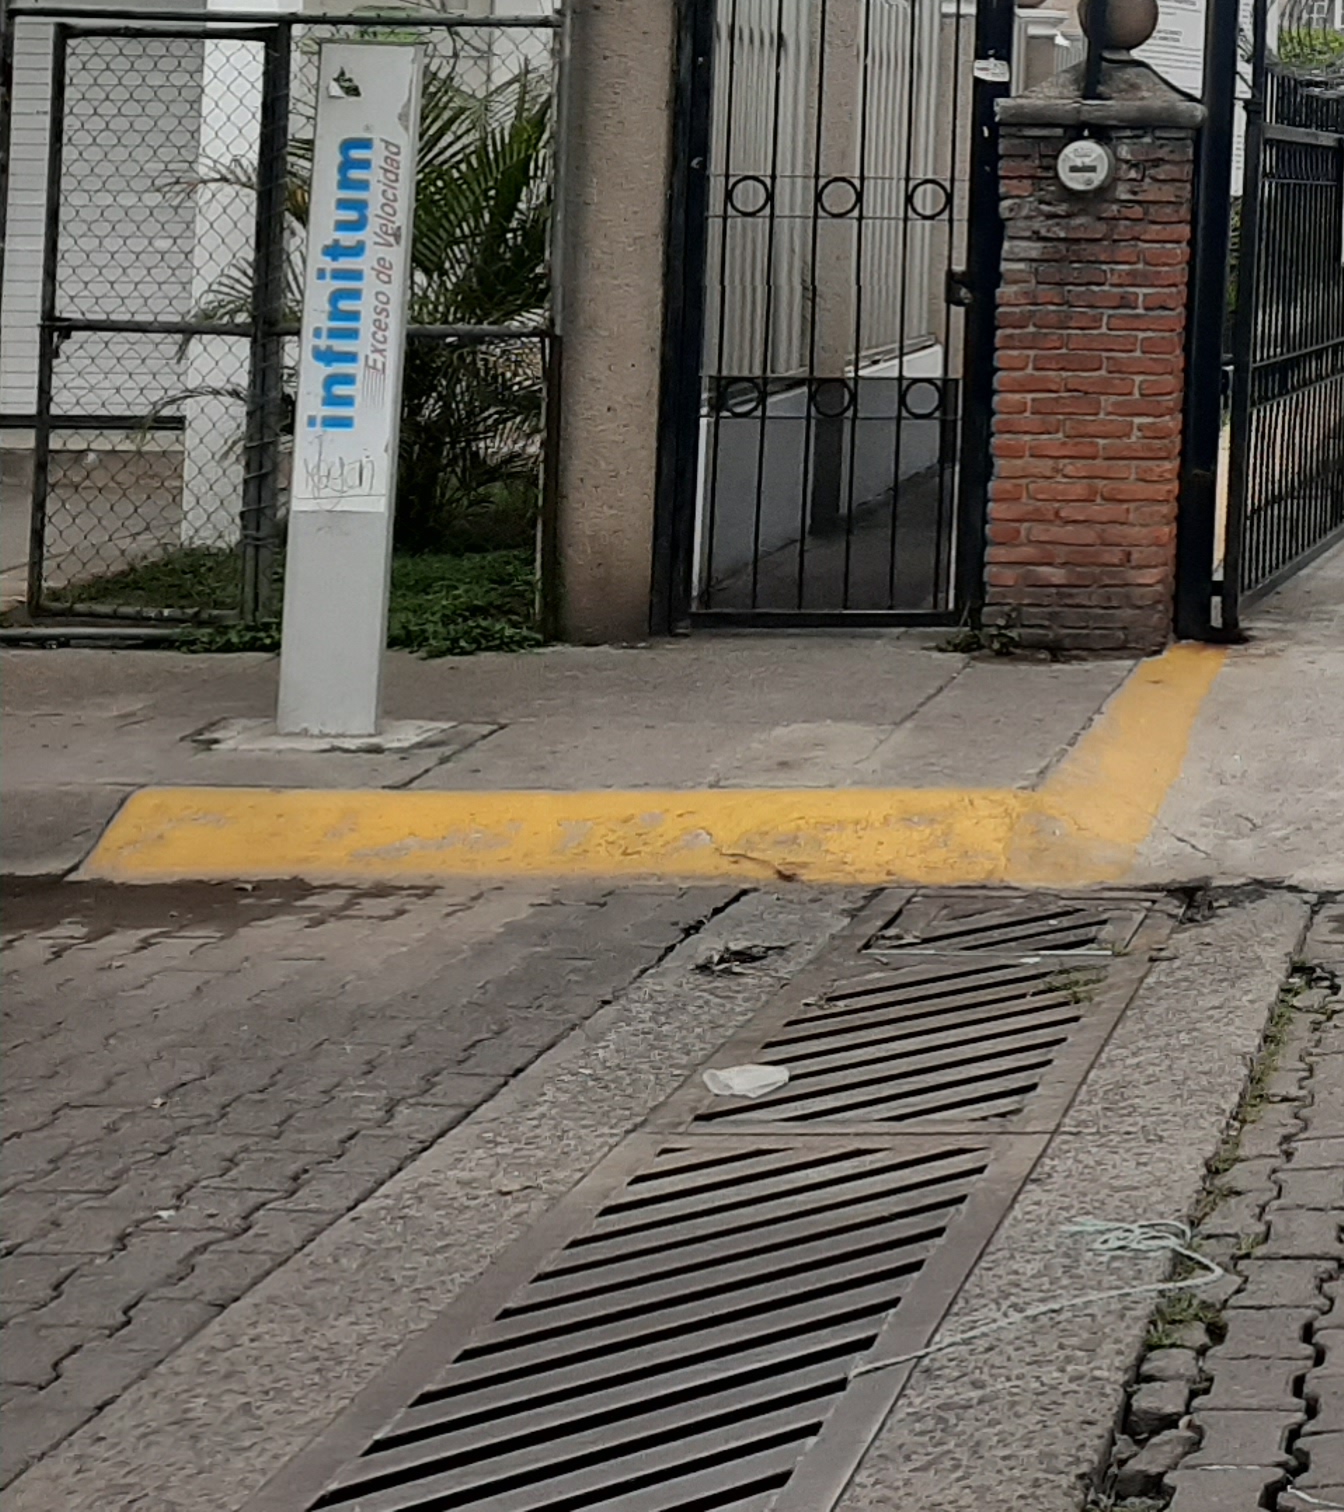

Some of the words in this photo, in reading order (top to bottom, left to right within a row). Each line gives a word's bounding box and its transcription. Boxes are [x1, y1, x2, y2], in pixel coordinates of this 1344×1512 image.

[373, 137, 401, 249] Velocidad
[307, 137, 374, 431] infinitum
[370, 256, 393, 285] de
[365, 290, 391, 375] Exceso
